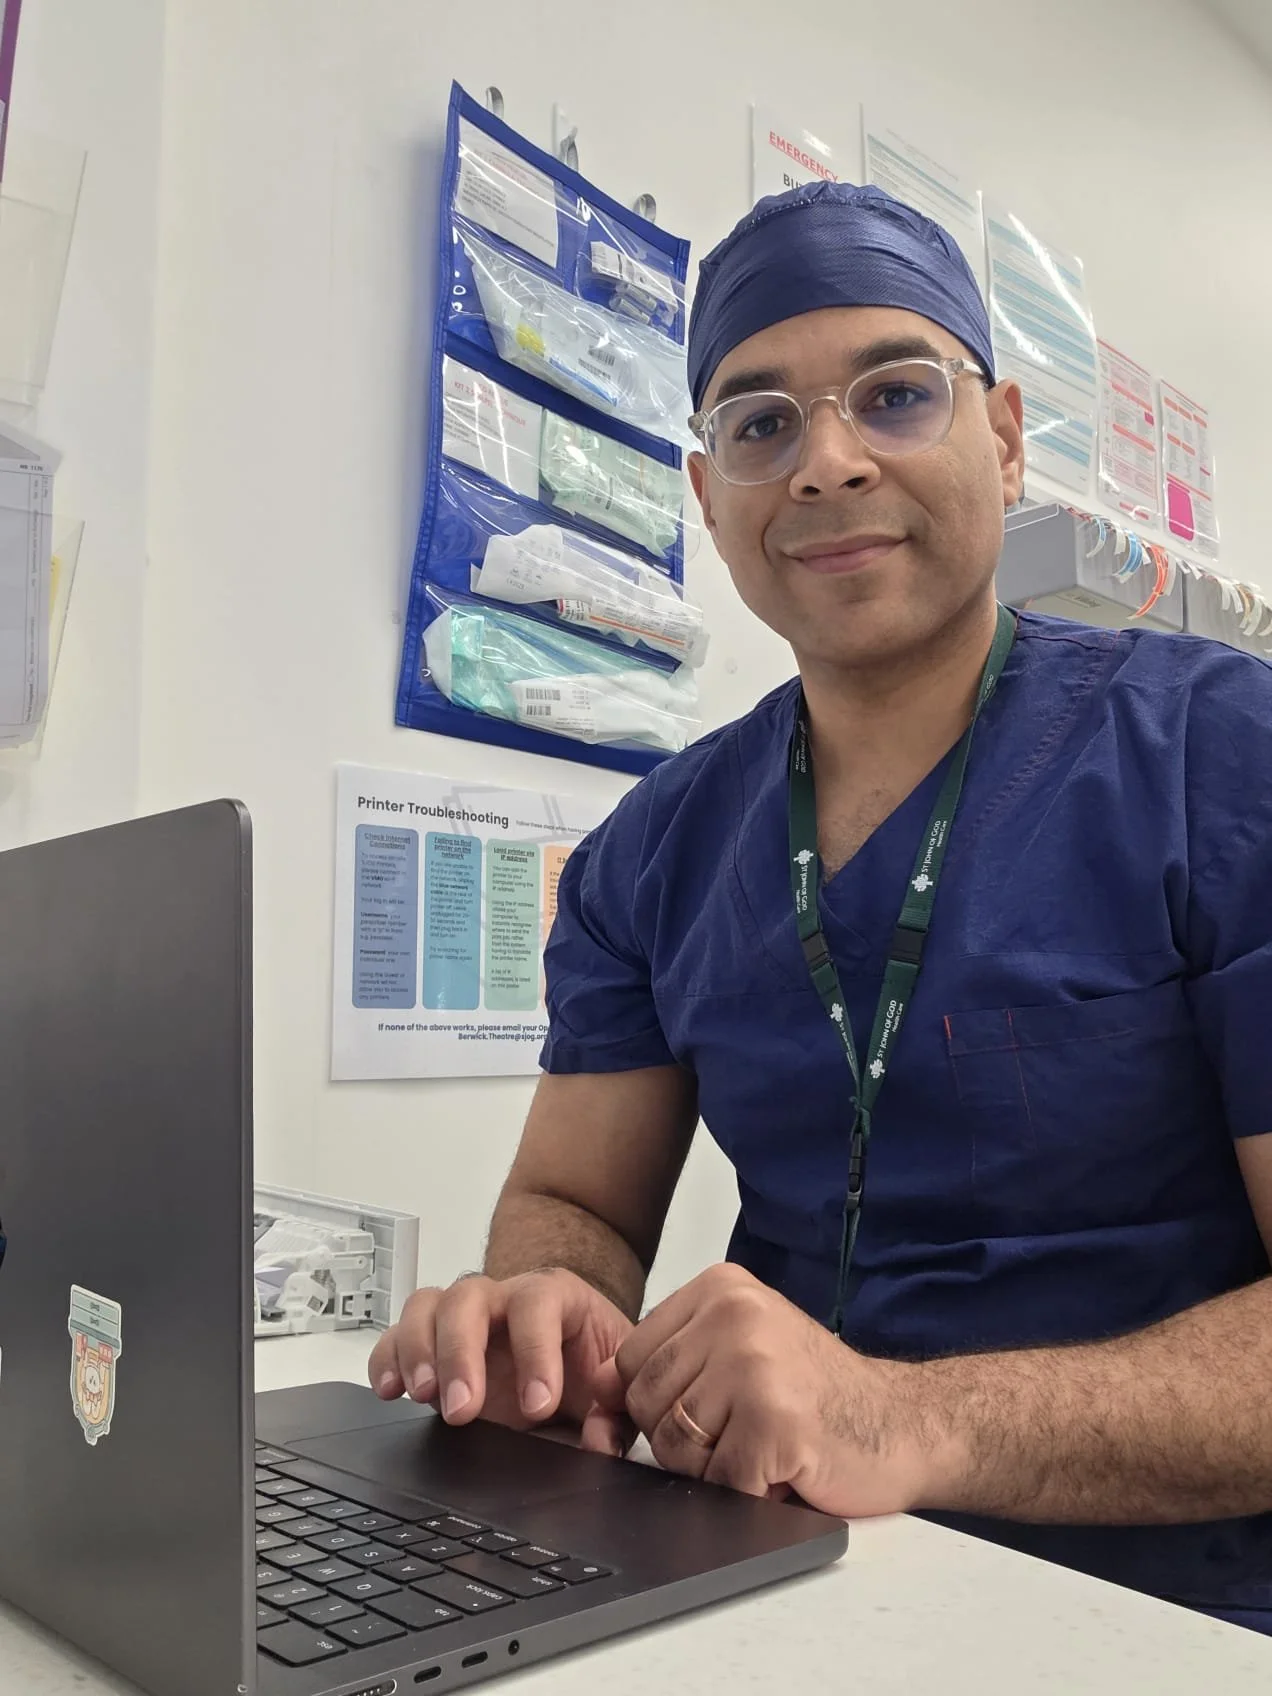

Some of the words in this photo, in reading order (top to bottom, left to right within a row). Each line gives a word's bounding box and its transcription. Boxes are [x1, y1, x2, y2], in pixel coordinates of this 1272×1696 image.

[768, 131, 838, 183] EMERGENCY
[358, 796, 405, 814] Printer
[407, 802, 509, 829] Troubleshooting
[931, 820, 941, 836] GOD
[923, 846, 934, 864] JOHN
[921, 864, 928, 872] ST
[886, 1000, 896, 1018] GOD
[429, 1024, 450, 1032] above
[452, 1024, 476, 1033] works,
[478, 1024, 500, 1034] please
[522, 1025, 537, 1033] your
[884, 1018, 892, 1029] OF
[880, 1029, 890, 1048] JOHN
[877, 1049, 884, 1058] ST
